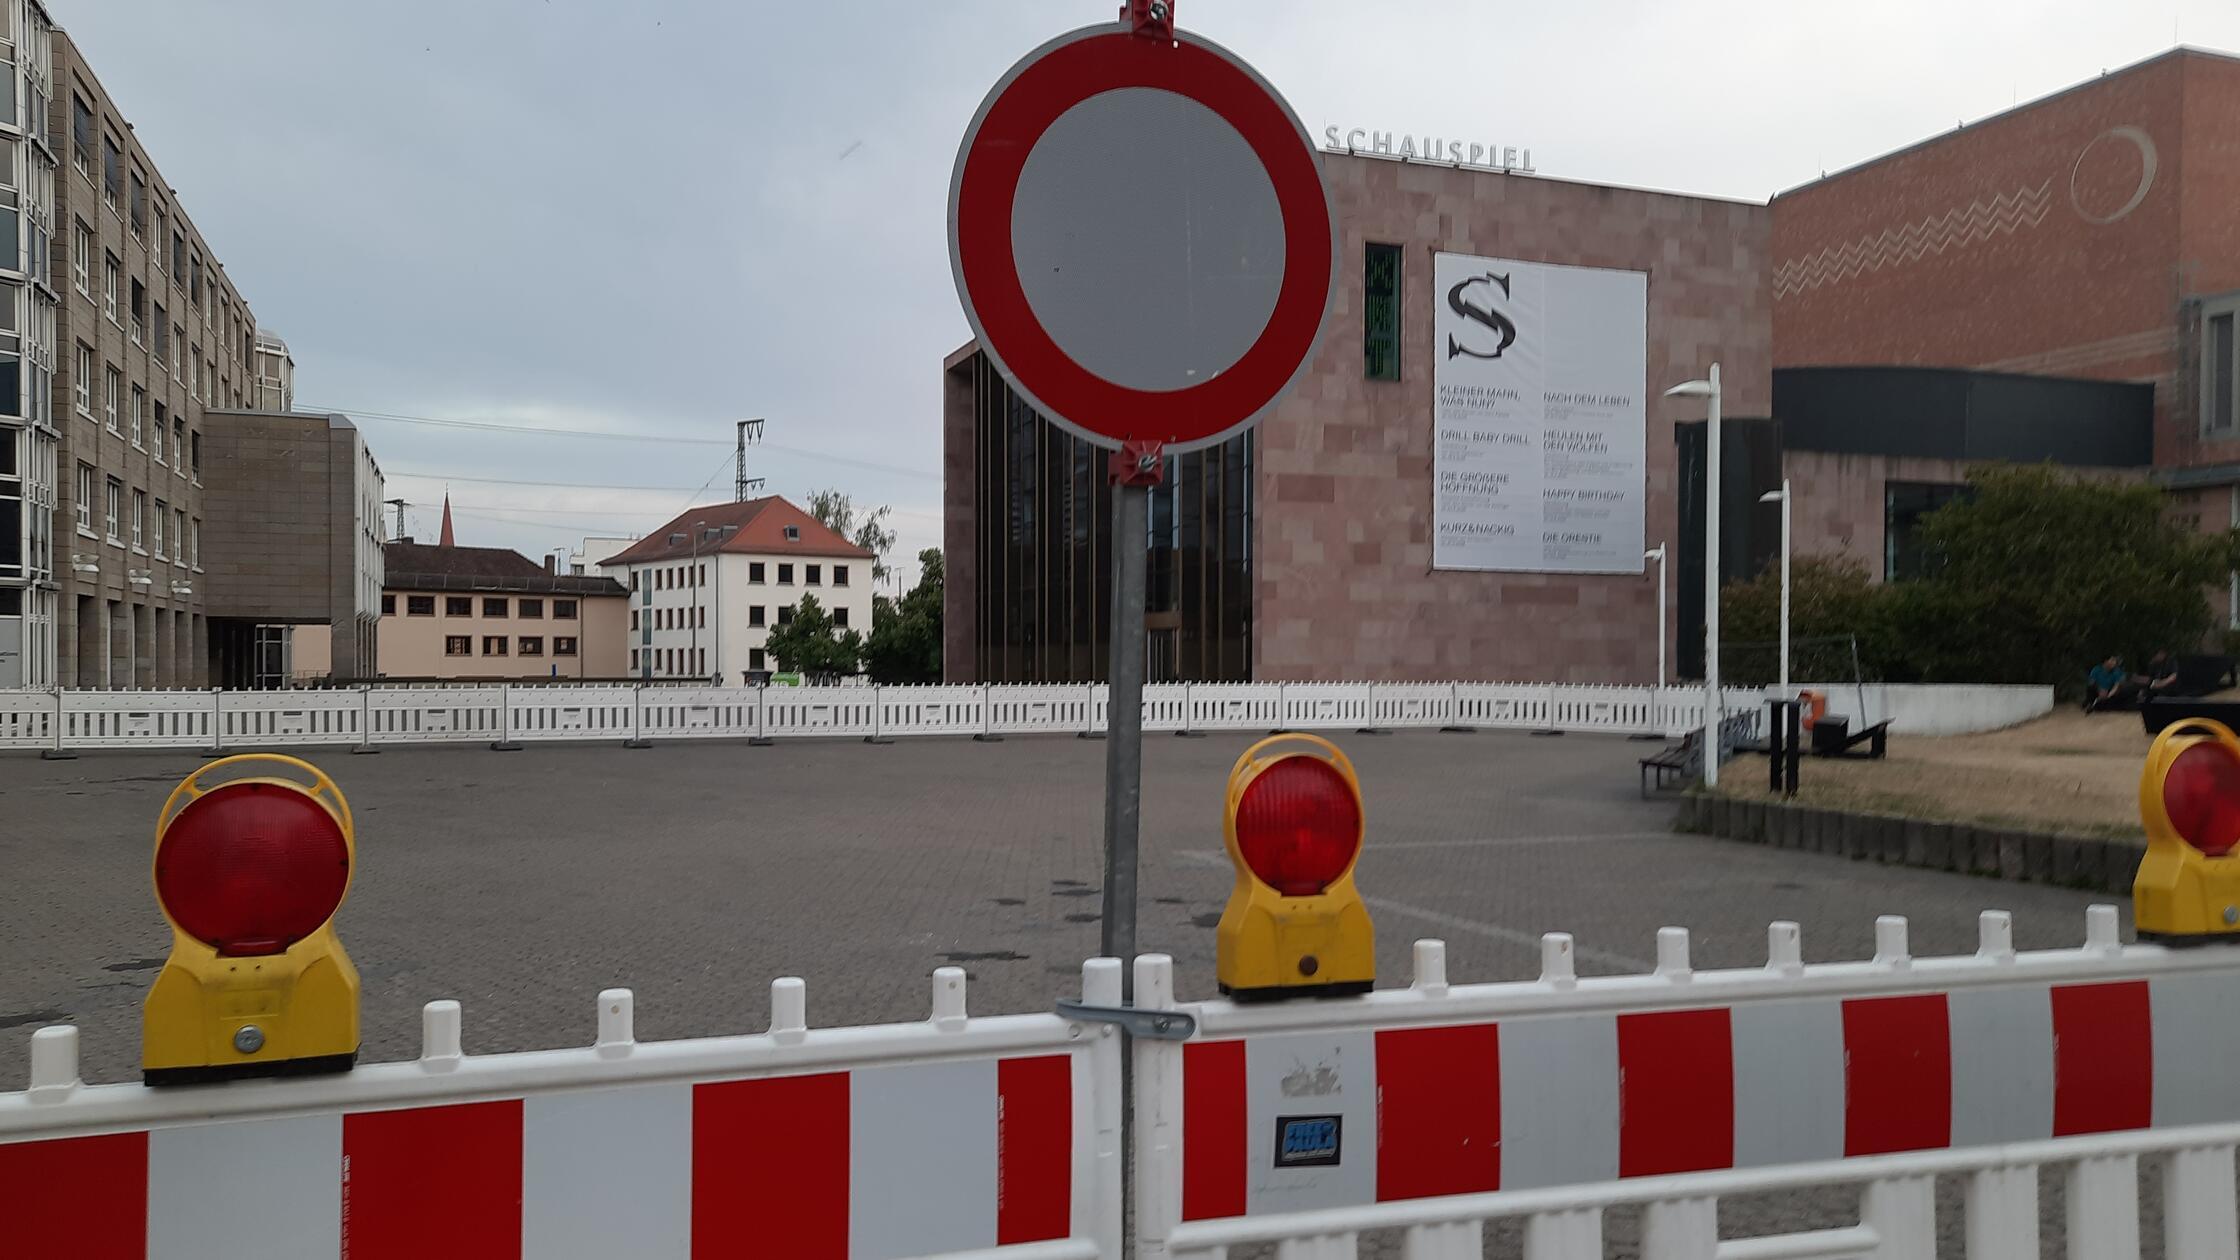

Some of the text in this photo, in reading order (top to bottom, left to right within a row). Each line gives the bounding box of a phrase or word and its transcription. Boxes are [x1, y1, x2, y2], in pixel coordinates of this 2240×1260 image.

[1325, 124, 1536, 172] SCHAUSPIEL
[1447, 271, 1516, 361] S
[1440, 384, 1484, 397] KLEINER
[1440, 396, 1465, 407] WAS
[1543, 392, 1631, 407] NACH DEM LEBEN
[1440, 430, 1529, 445] DRILL BABY DRILL
[1585, 431, 1603, 441] MIT
[1440, 471, 1457, 481] DIE
[1440, 481, 1499, 494] HOFFNUNG
[1542, 488, 1625, 502] HAPPY BIRTHDAY
[1542, 532, 1558, 543] DIE
